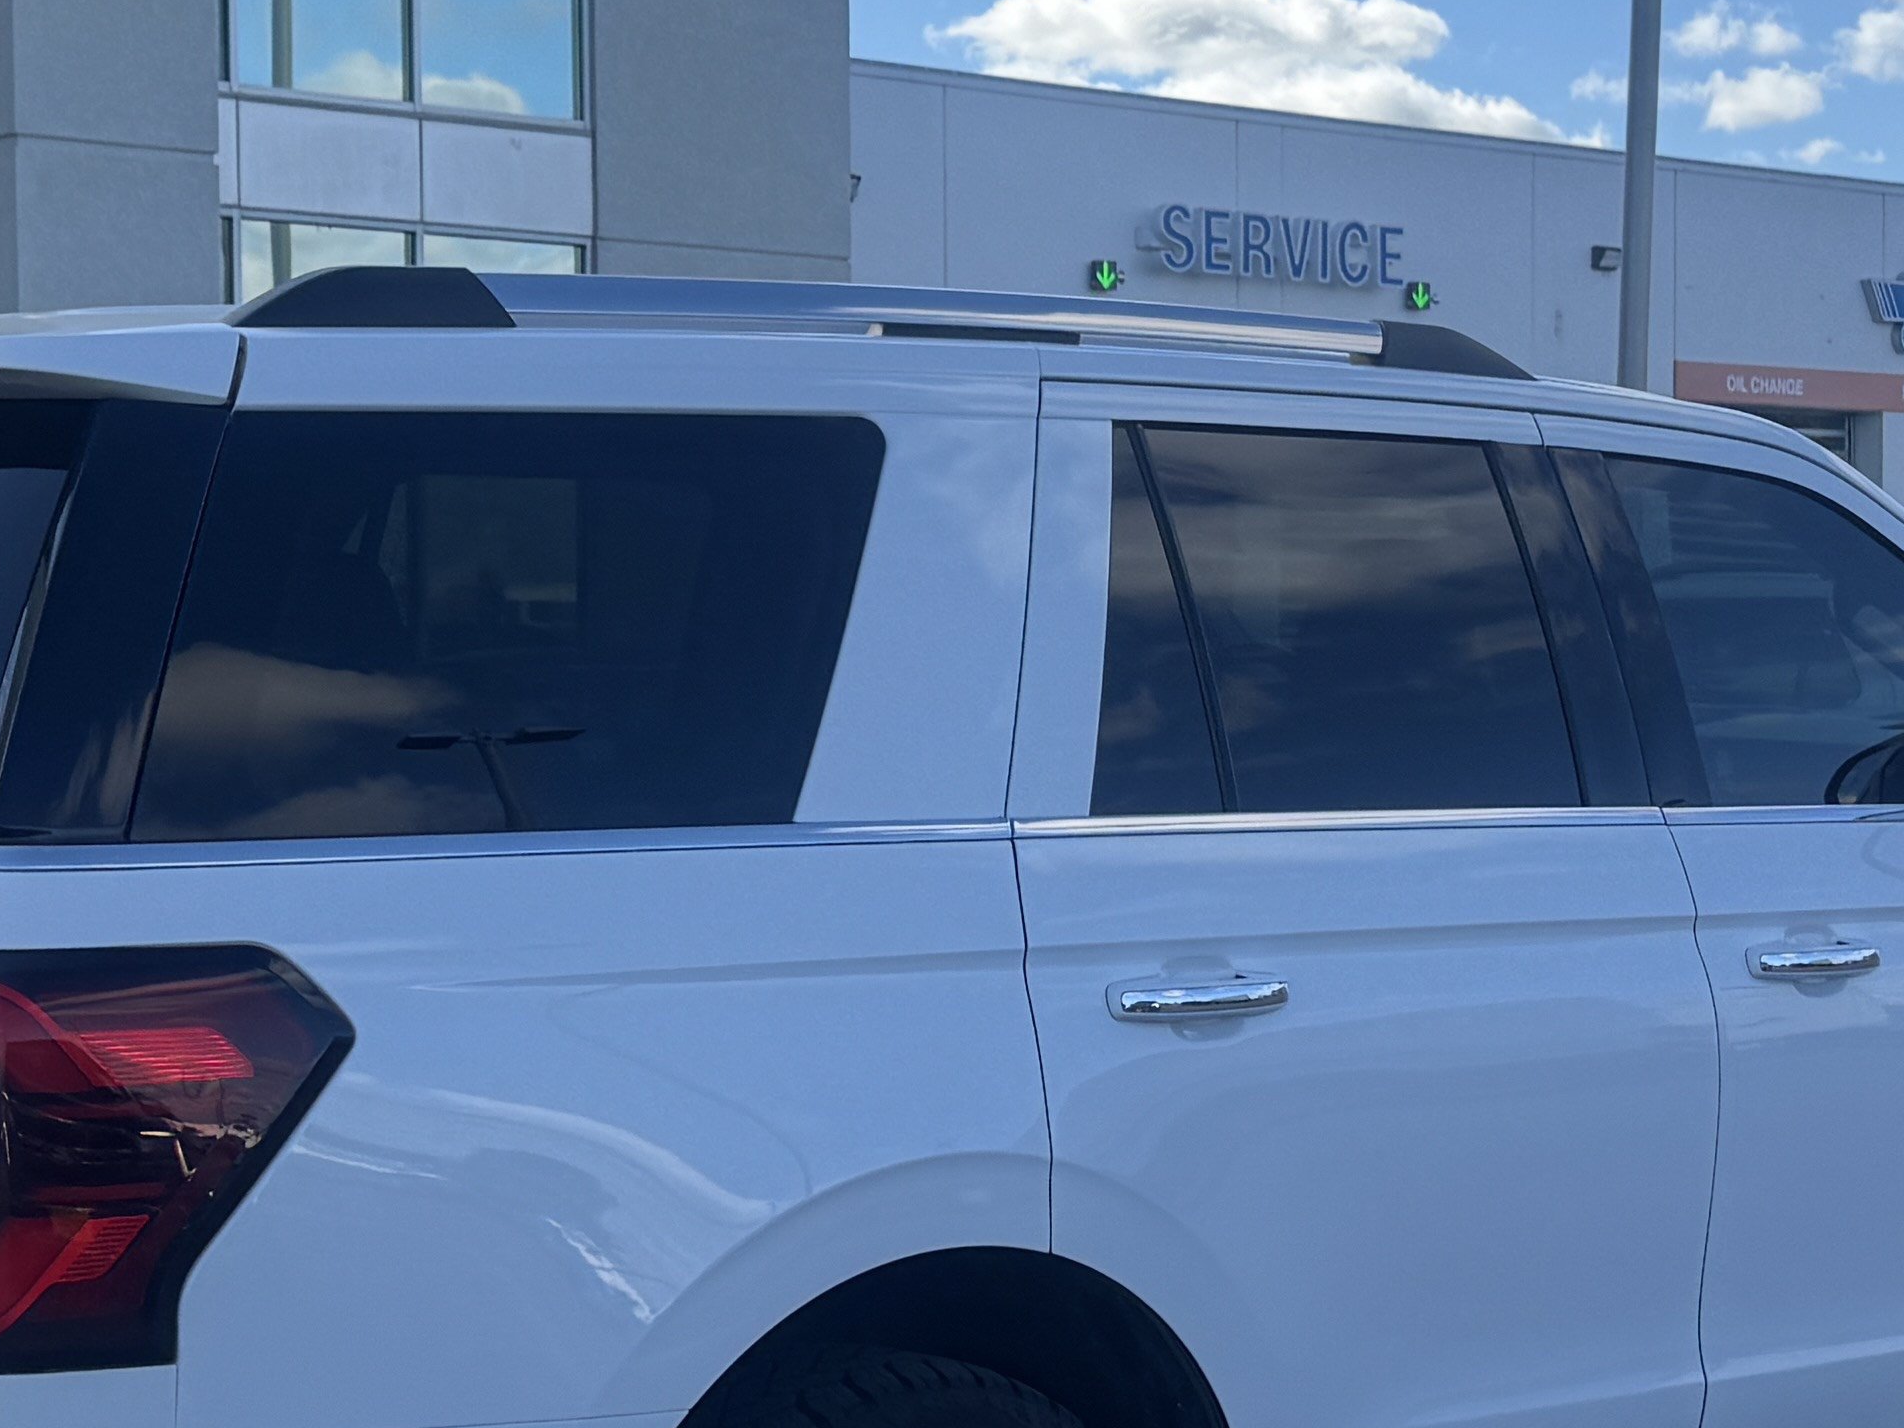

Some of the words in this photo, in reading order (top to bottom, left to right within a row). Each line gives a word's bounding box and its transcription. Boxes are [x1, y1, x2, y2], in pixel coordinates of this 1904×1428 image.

[1160, 203, 1405, 288] SERVICE
[1726, 375, 1747, 393] OIL
[1750, 376, 1804, 396] CHANGE
